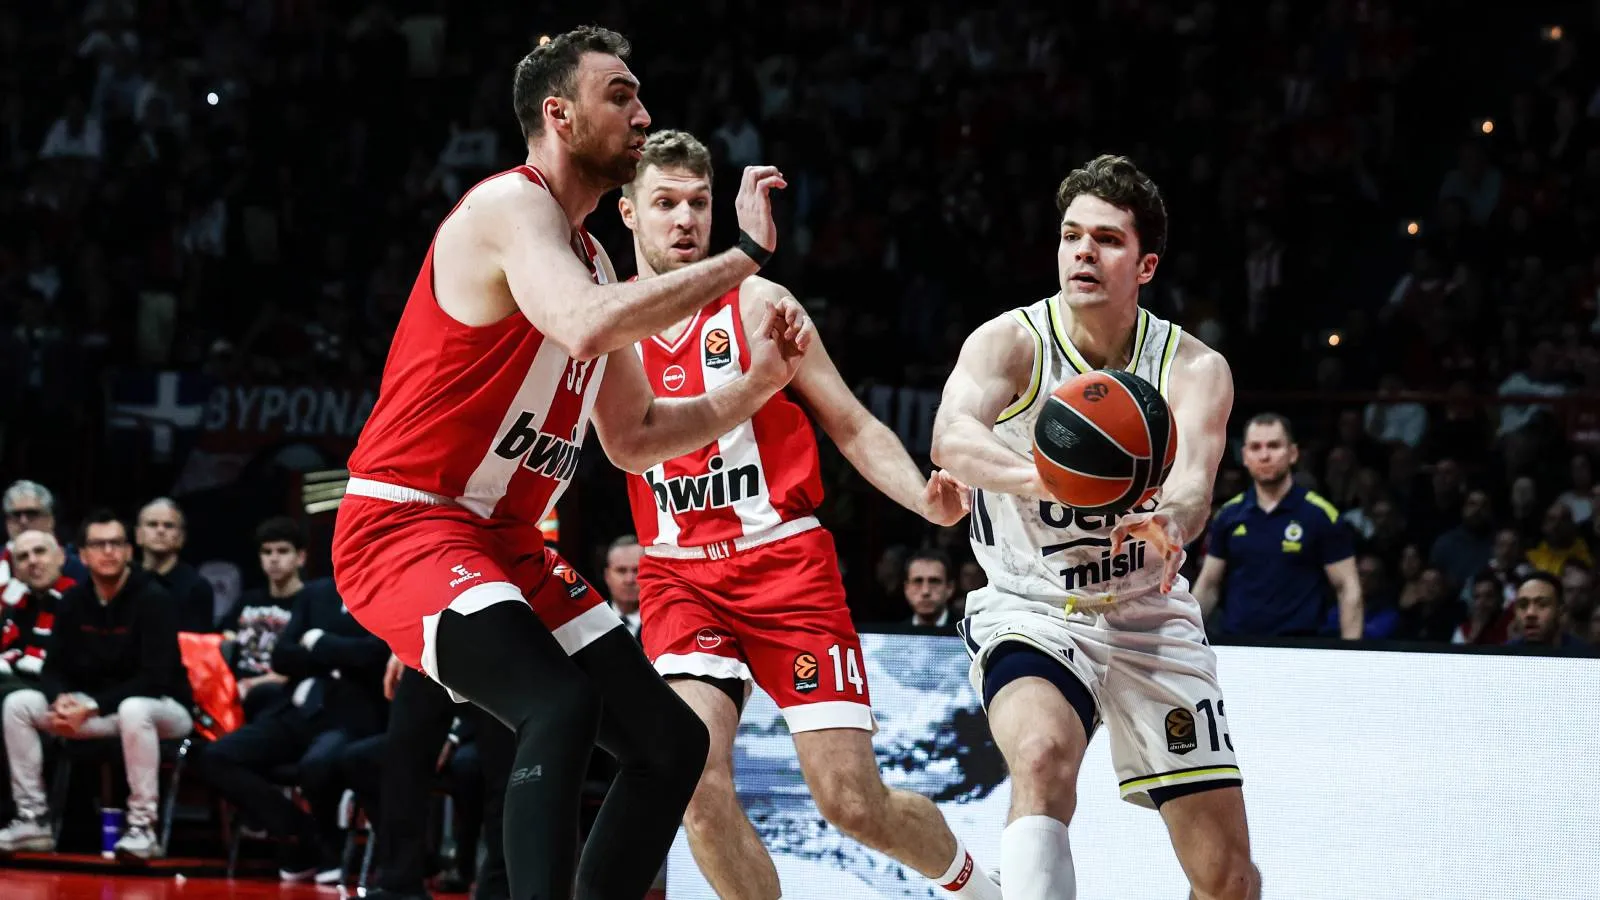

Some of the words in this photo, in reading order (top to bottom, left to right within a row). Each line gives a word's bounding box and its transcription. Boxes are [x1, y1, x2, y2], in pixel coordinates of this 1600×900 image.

[646, 455, 760, 514] bwin
[1060, 541, 1146, 591] misli
[828, 644, 864, 694] 14
